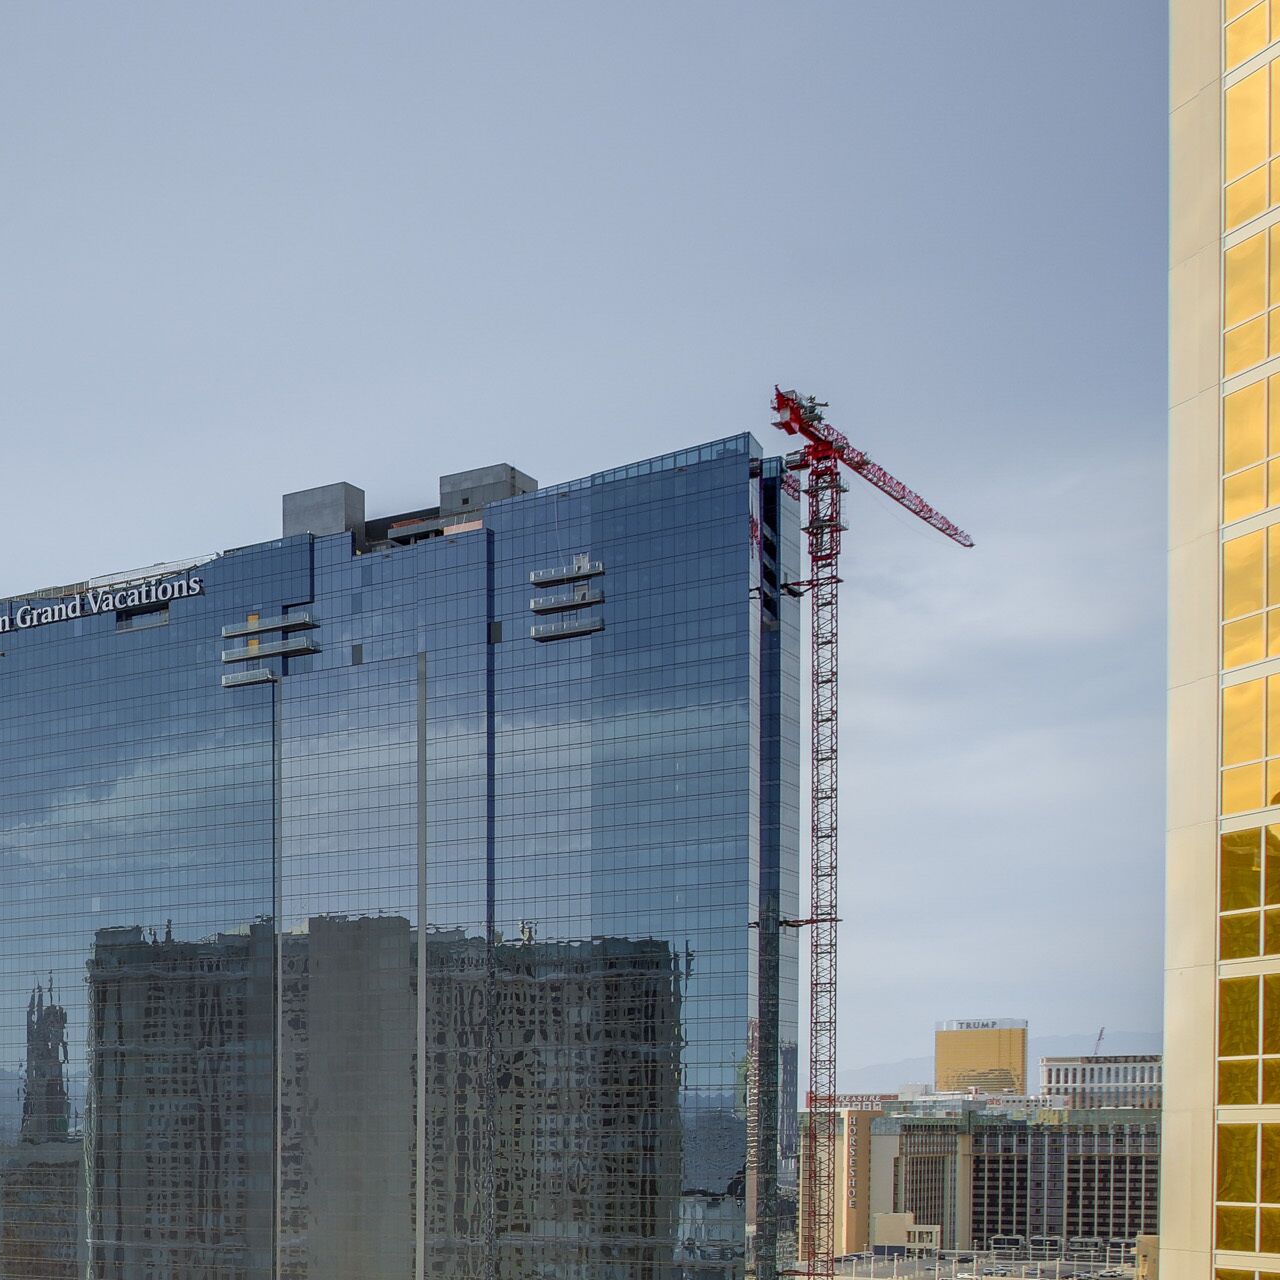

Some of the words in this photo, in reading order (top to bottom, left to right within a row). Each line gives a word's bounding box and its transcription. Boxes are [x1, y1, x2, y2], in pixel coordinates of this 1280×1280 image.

[16, 597, 81, 629] Grand
[86, 576, 201, 613] Vacations
[958, 1021, 997, 1029] TRUMP
[1085, 1055, 1160, 1063] VENETIAN
[848, 1116, 857, 1208] HORSESHOE
